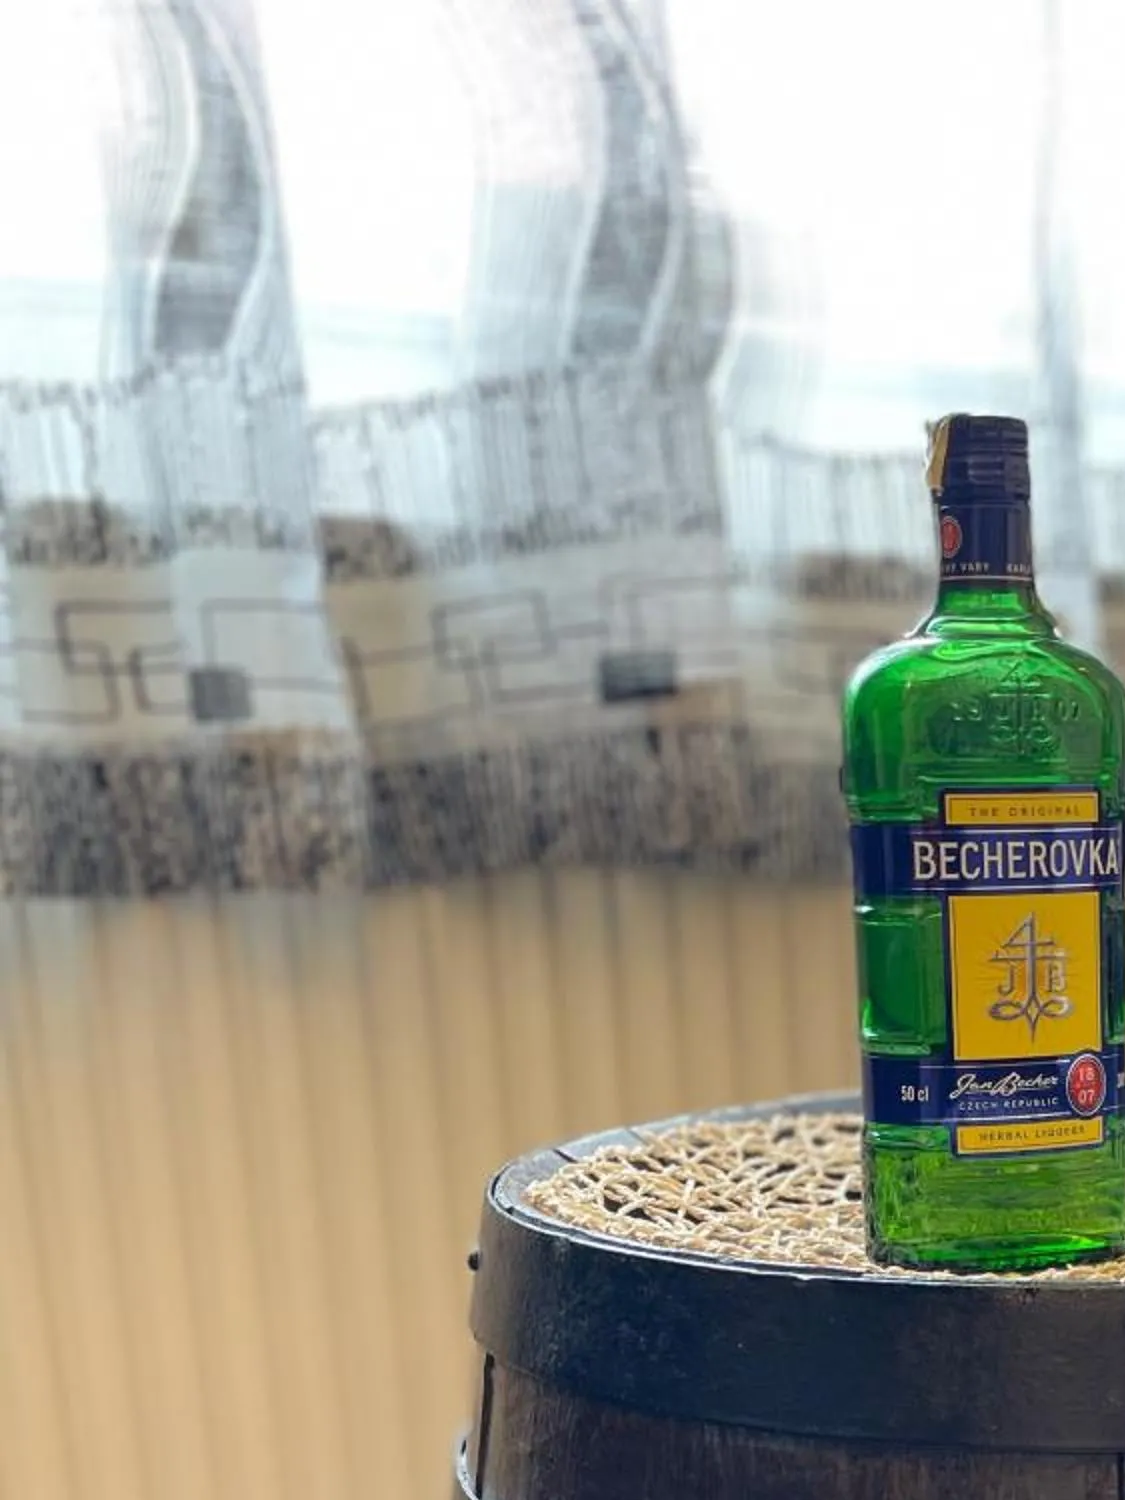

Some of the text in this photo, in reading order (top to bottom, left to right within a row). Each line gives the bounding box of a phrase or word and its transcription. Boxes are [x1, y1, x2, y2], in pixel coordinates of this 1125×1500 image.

[968, 804, 1081, 817] THE ORIGINAL
[913, 839, 1120, 880] BECHEROVKA
[1078, 1067, 1096, 1081] 18
[990, 1071, 1059, 1097] Becher
[901, 1085, 929, 1101] 50 cl
[1077, 1088, 1096, 1105] 07
[959, 1097, 1059, 1111] CZECH REPUBLIC
[978, 1129, 1029, 1142] HERBAL
